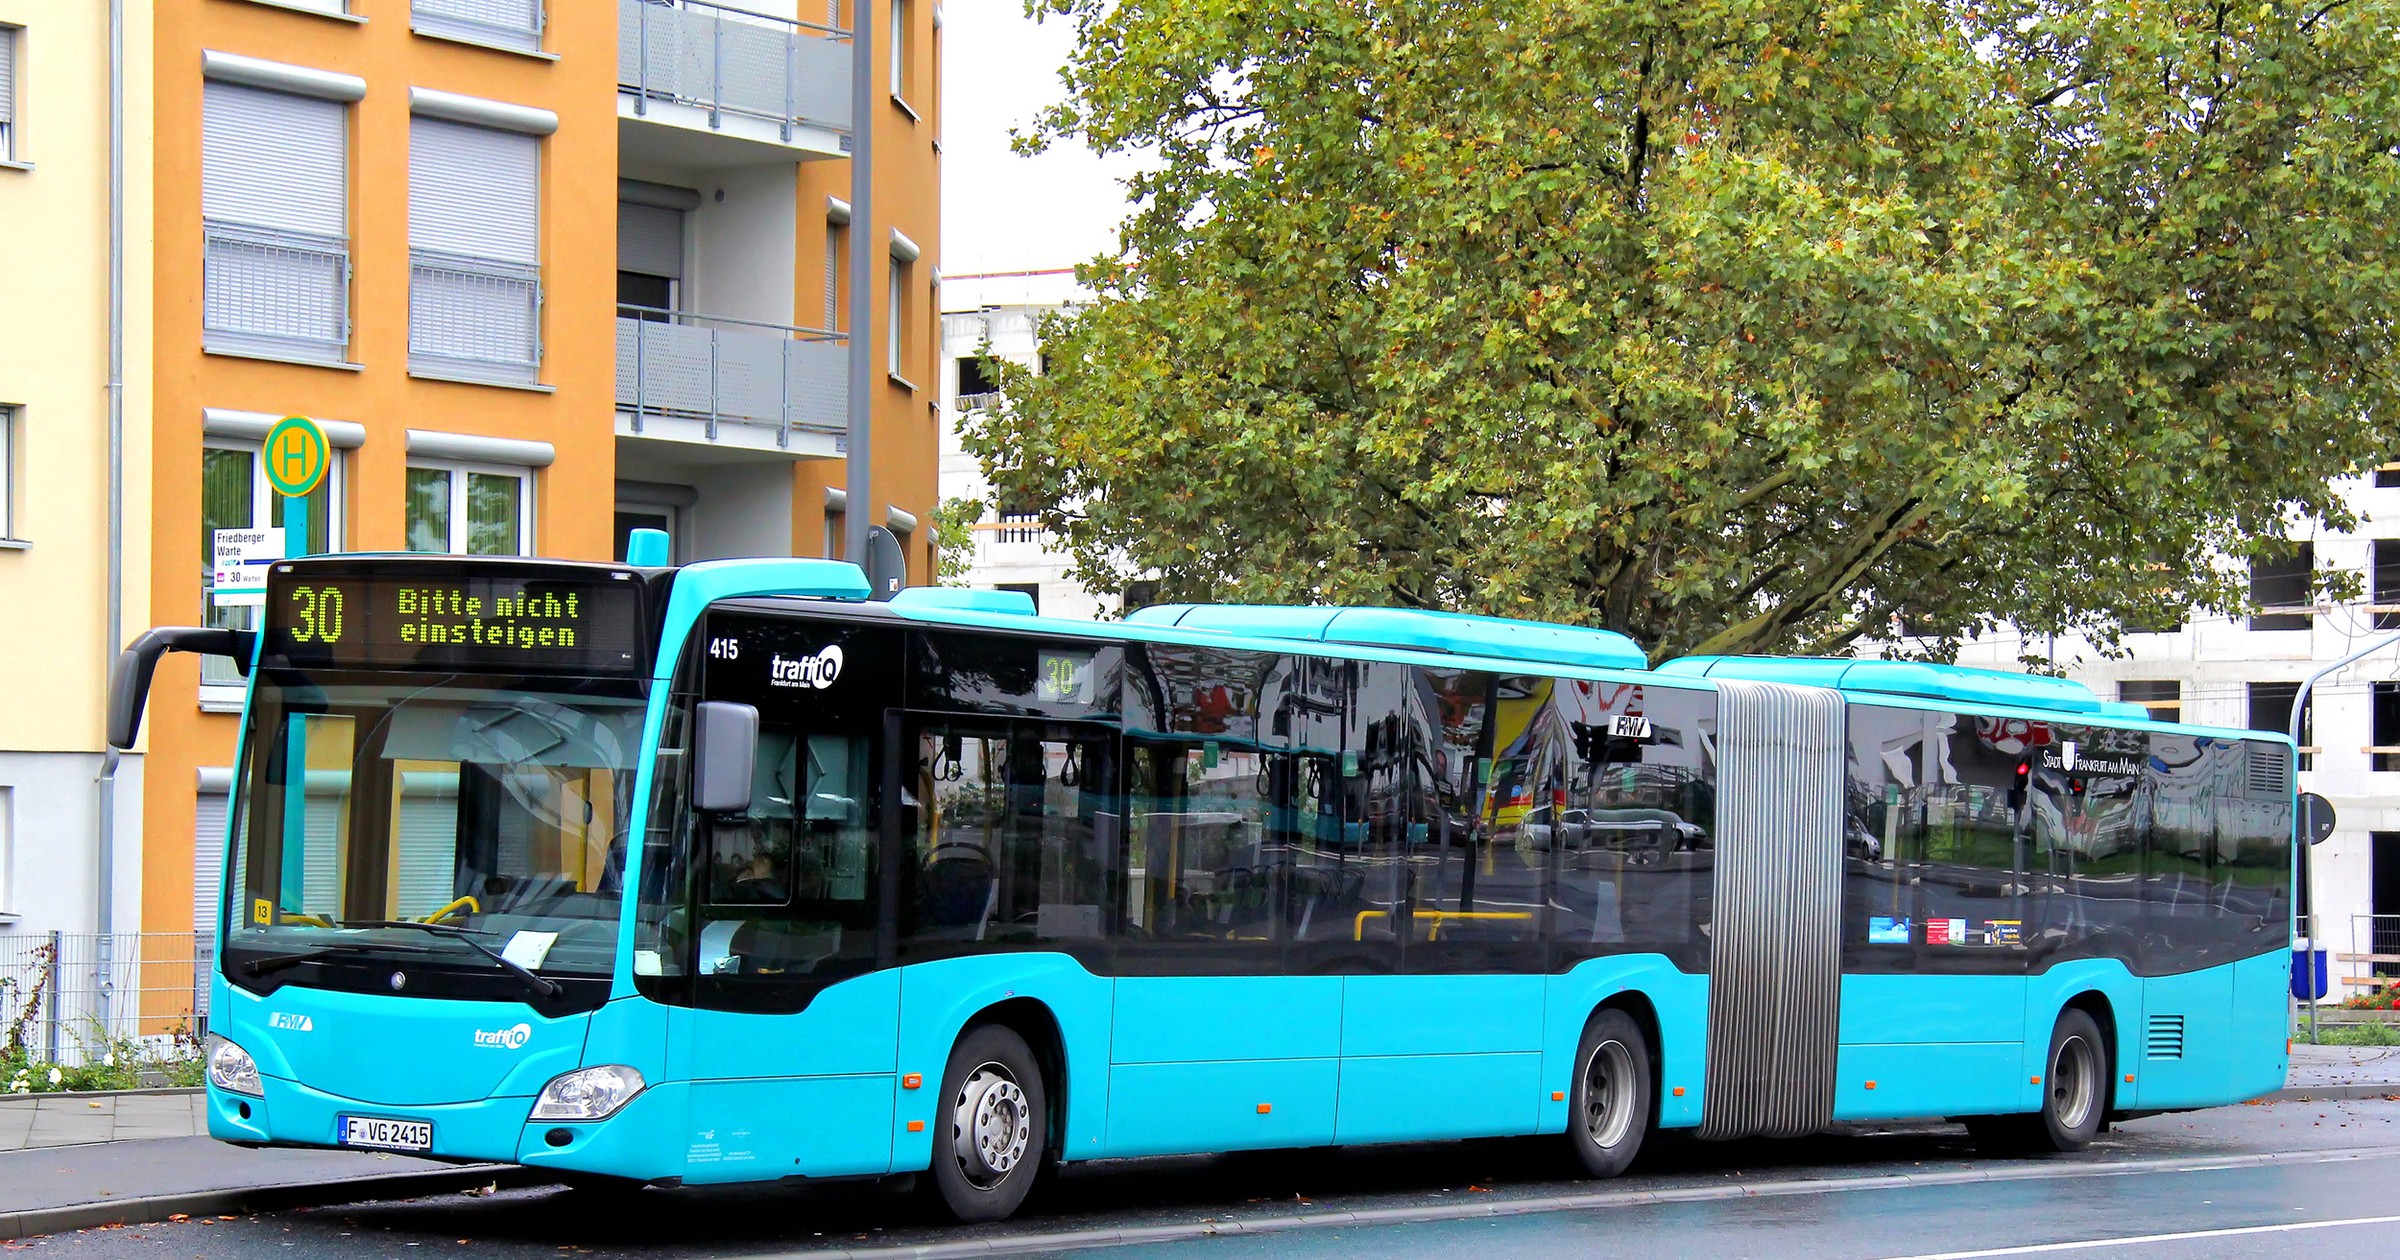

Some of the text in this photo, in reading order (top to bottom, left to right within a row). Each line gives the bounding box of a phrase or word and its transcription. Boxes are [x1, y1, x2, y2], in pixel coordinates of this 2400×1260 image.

[283, 434, 306, 477] H
[217, 533, 265, 545] Friedberger
[217, 546, 241, 556] Warte
[230, 572, 241, 583] 30
[292, 586, 343, 643] 30
[398, 588, 579, 618] Bitte nicht
[400, 616, 575, 649] einsteigen
[710, 638, 739, 660] 415
[772, 650, 840, 685] traffiQ
[1046, 658, 1072, 694] 30
[258, 905, 267, 918] 13
[474, 1025, 528, 1047] traffiQ
[348, 1120, 358, 1138] F
[368, 1122, 387, 1142] VG
[391, 1124, 428, 1145] 2415
